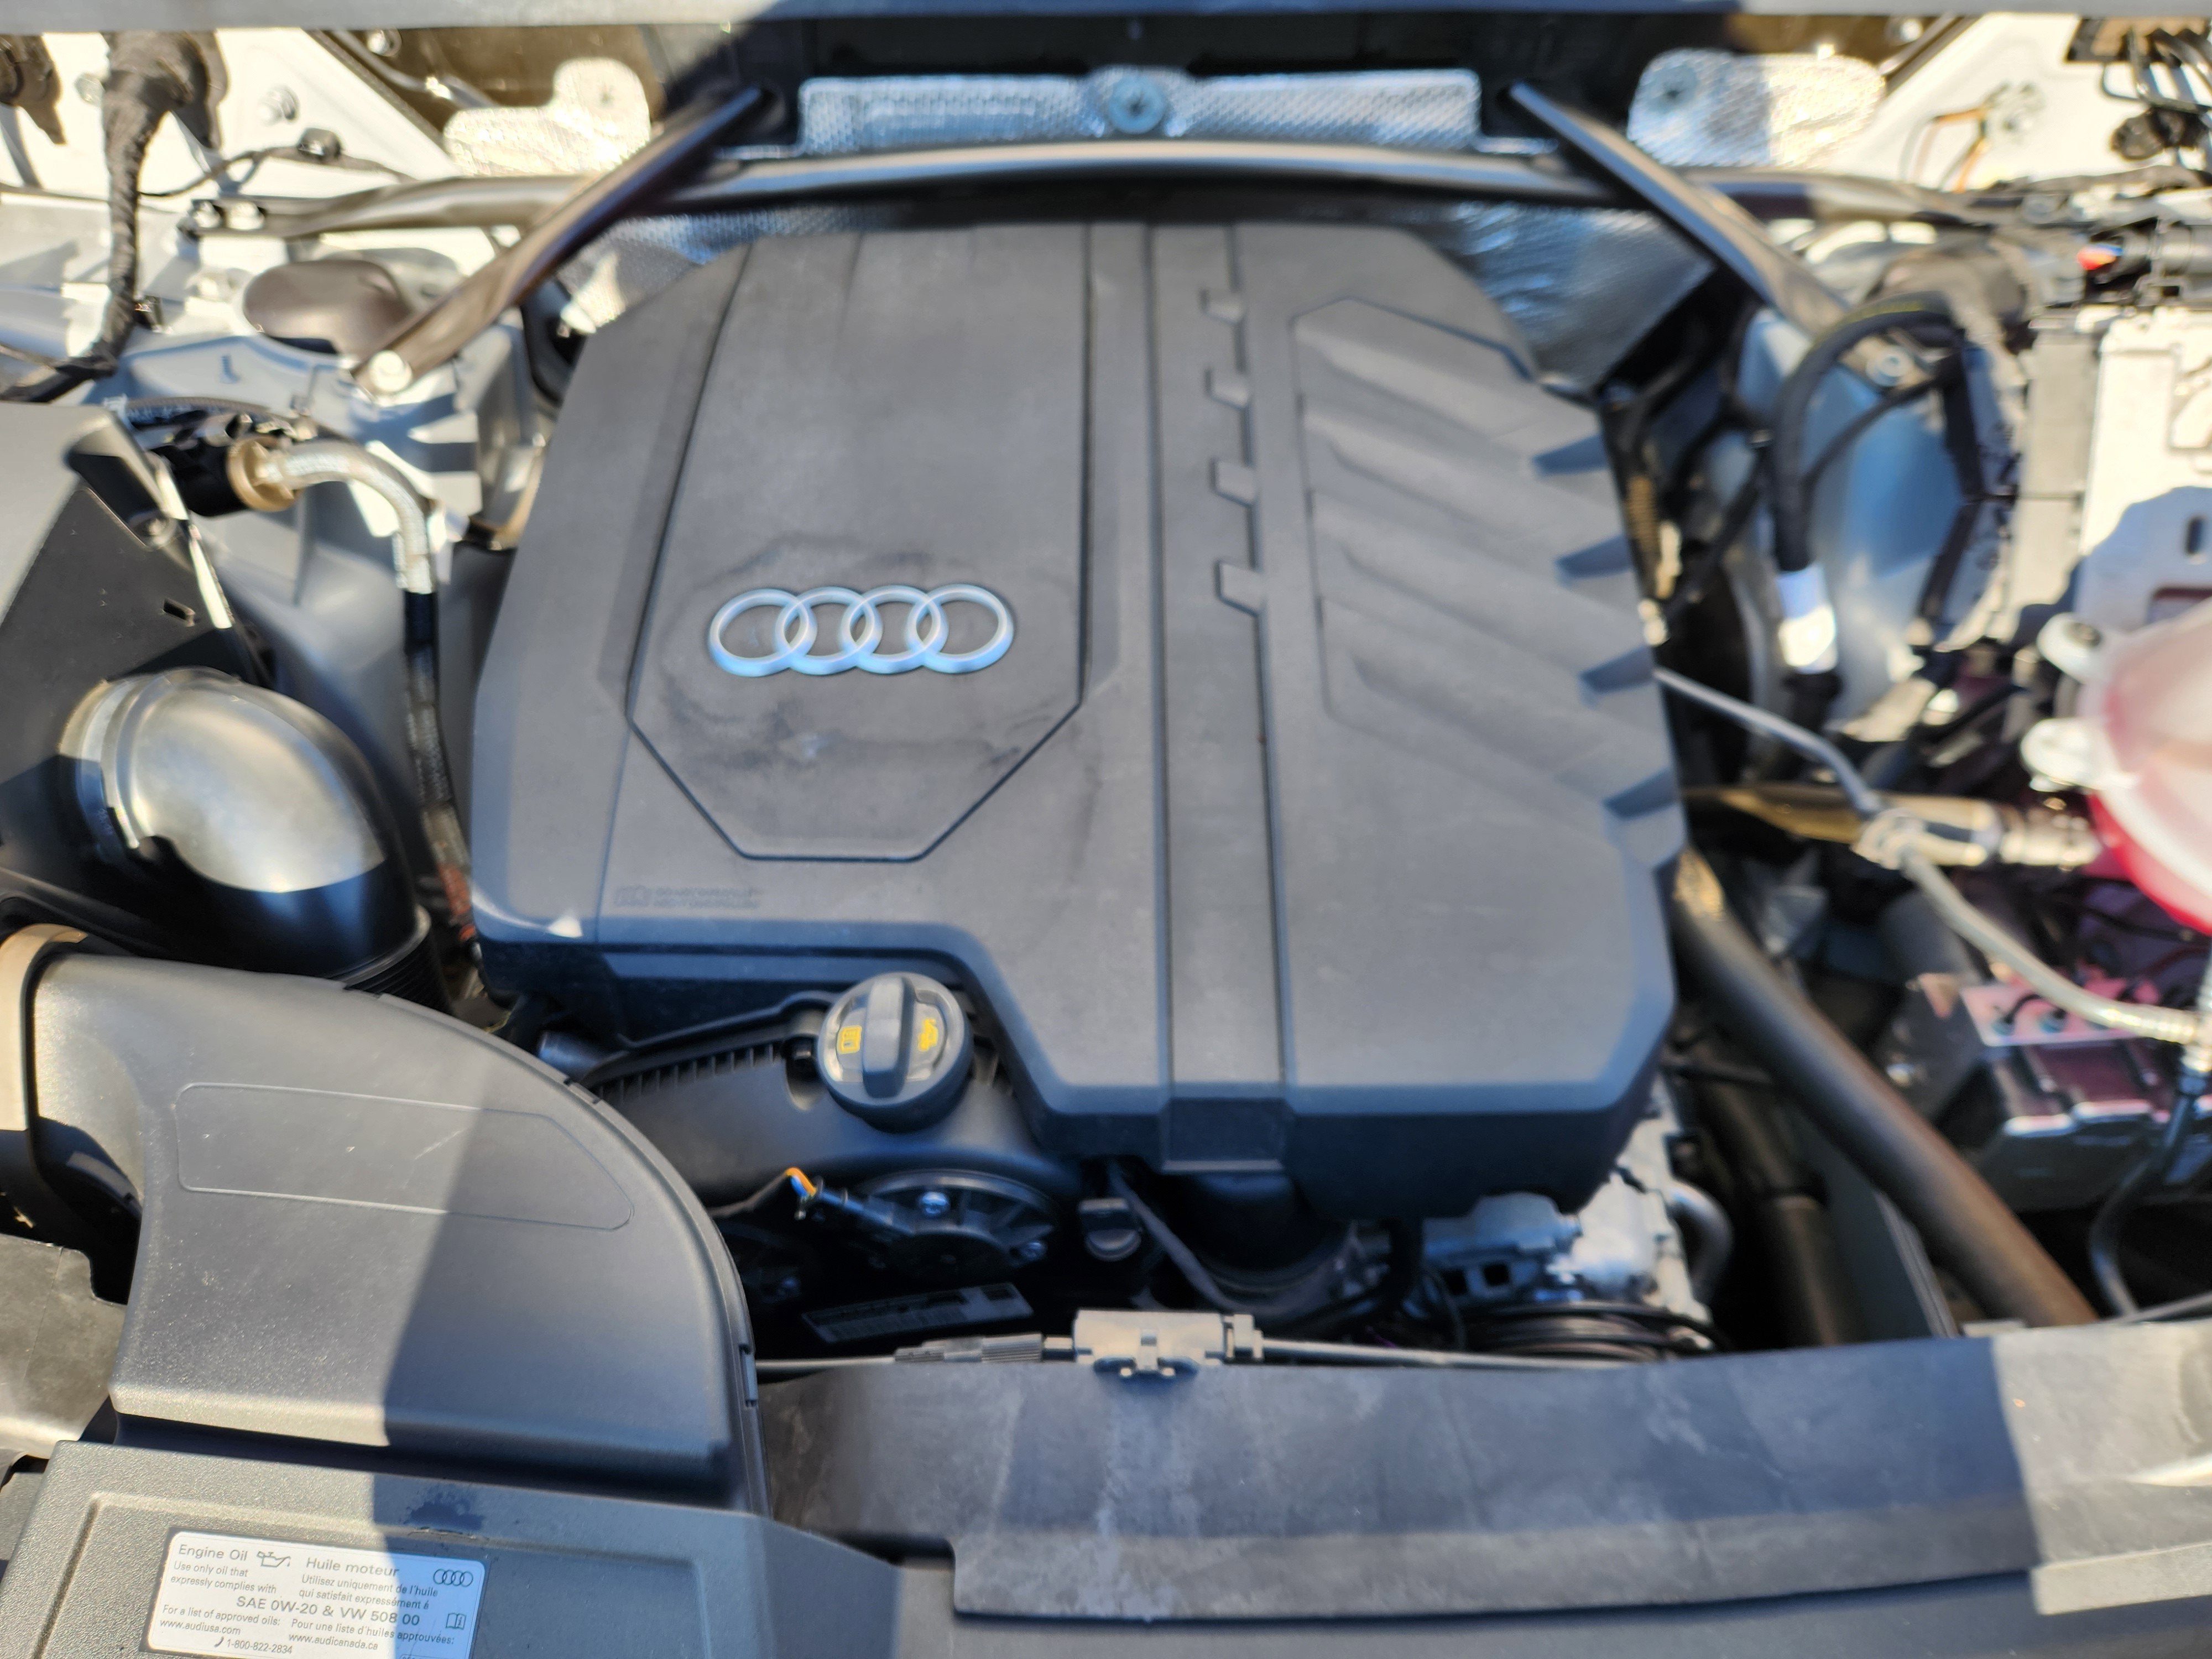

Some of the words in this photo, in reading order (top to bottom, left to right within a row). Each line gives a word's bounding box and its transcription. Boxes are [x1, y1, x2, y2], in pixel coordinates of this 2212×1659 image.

[179, 1544, 225, 1559] Engine
[229, 1550, 248, 1561] Oil
[174, 1561, 191, 1572] Use
[194, 1563, 214, 1575] only
[216, 1566, 228, 1575] oil
[230, 1568, 248, 1577] that
[306, 1557, 341, 1571] Huile
[345, 1564, 399, 1577] moteur
[171, 1576, 213, 1589] expressly
[215, 1580, 254, 1593] complies
[258, 1584, 276, 1594] with
[301, 1574, 334, 1587] Utilisez
[337, 1579, 392, 1593] uniquement
[395, 1583, 407, 1594] de
[299, 1588, 315, 1598] qui
[316, 1590, 352, 1603] satisfait
[163, 1604, 179, 1615] For
[187, 1608, 202, 1619] list
[204, 1609, 214, 1620] of
[215, 1611, 259, 1625] approved
[261, 1614, 281, 1626] oils:
[236, 1596, 266, 1609] SAE
[270, 1600, 318, 1616] 0W-20
[322, 1605, 333, 1618] &
[340, 1605, 367, 1621] VW
[371, 1610, 398, 1624] 508
[402, 1613, 420, 1626] 00
[160, 1619, 241, 1635] www.audiusa.com
[291, 1618, 314, 1629] Pour
[315, 1621, 333, 1631] une
[335, 1624, 356, 1633] liste
[227, 1639, 293, 1655] 1-800-822-2834
[289, 1632, 378, 1651] www.audicanada.ca
